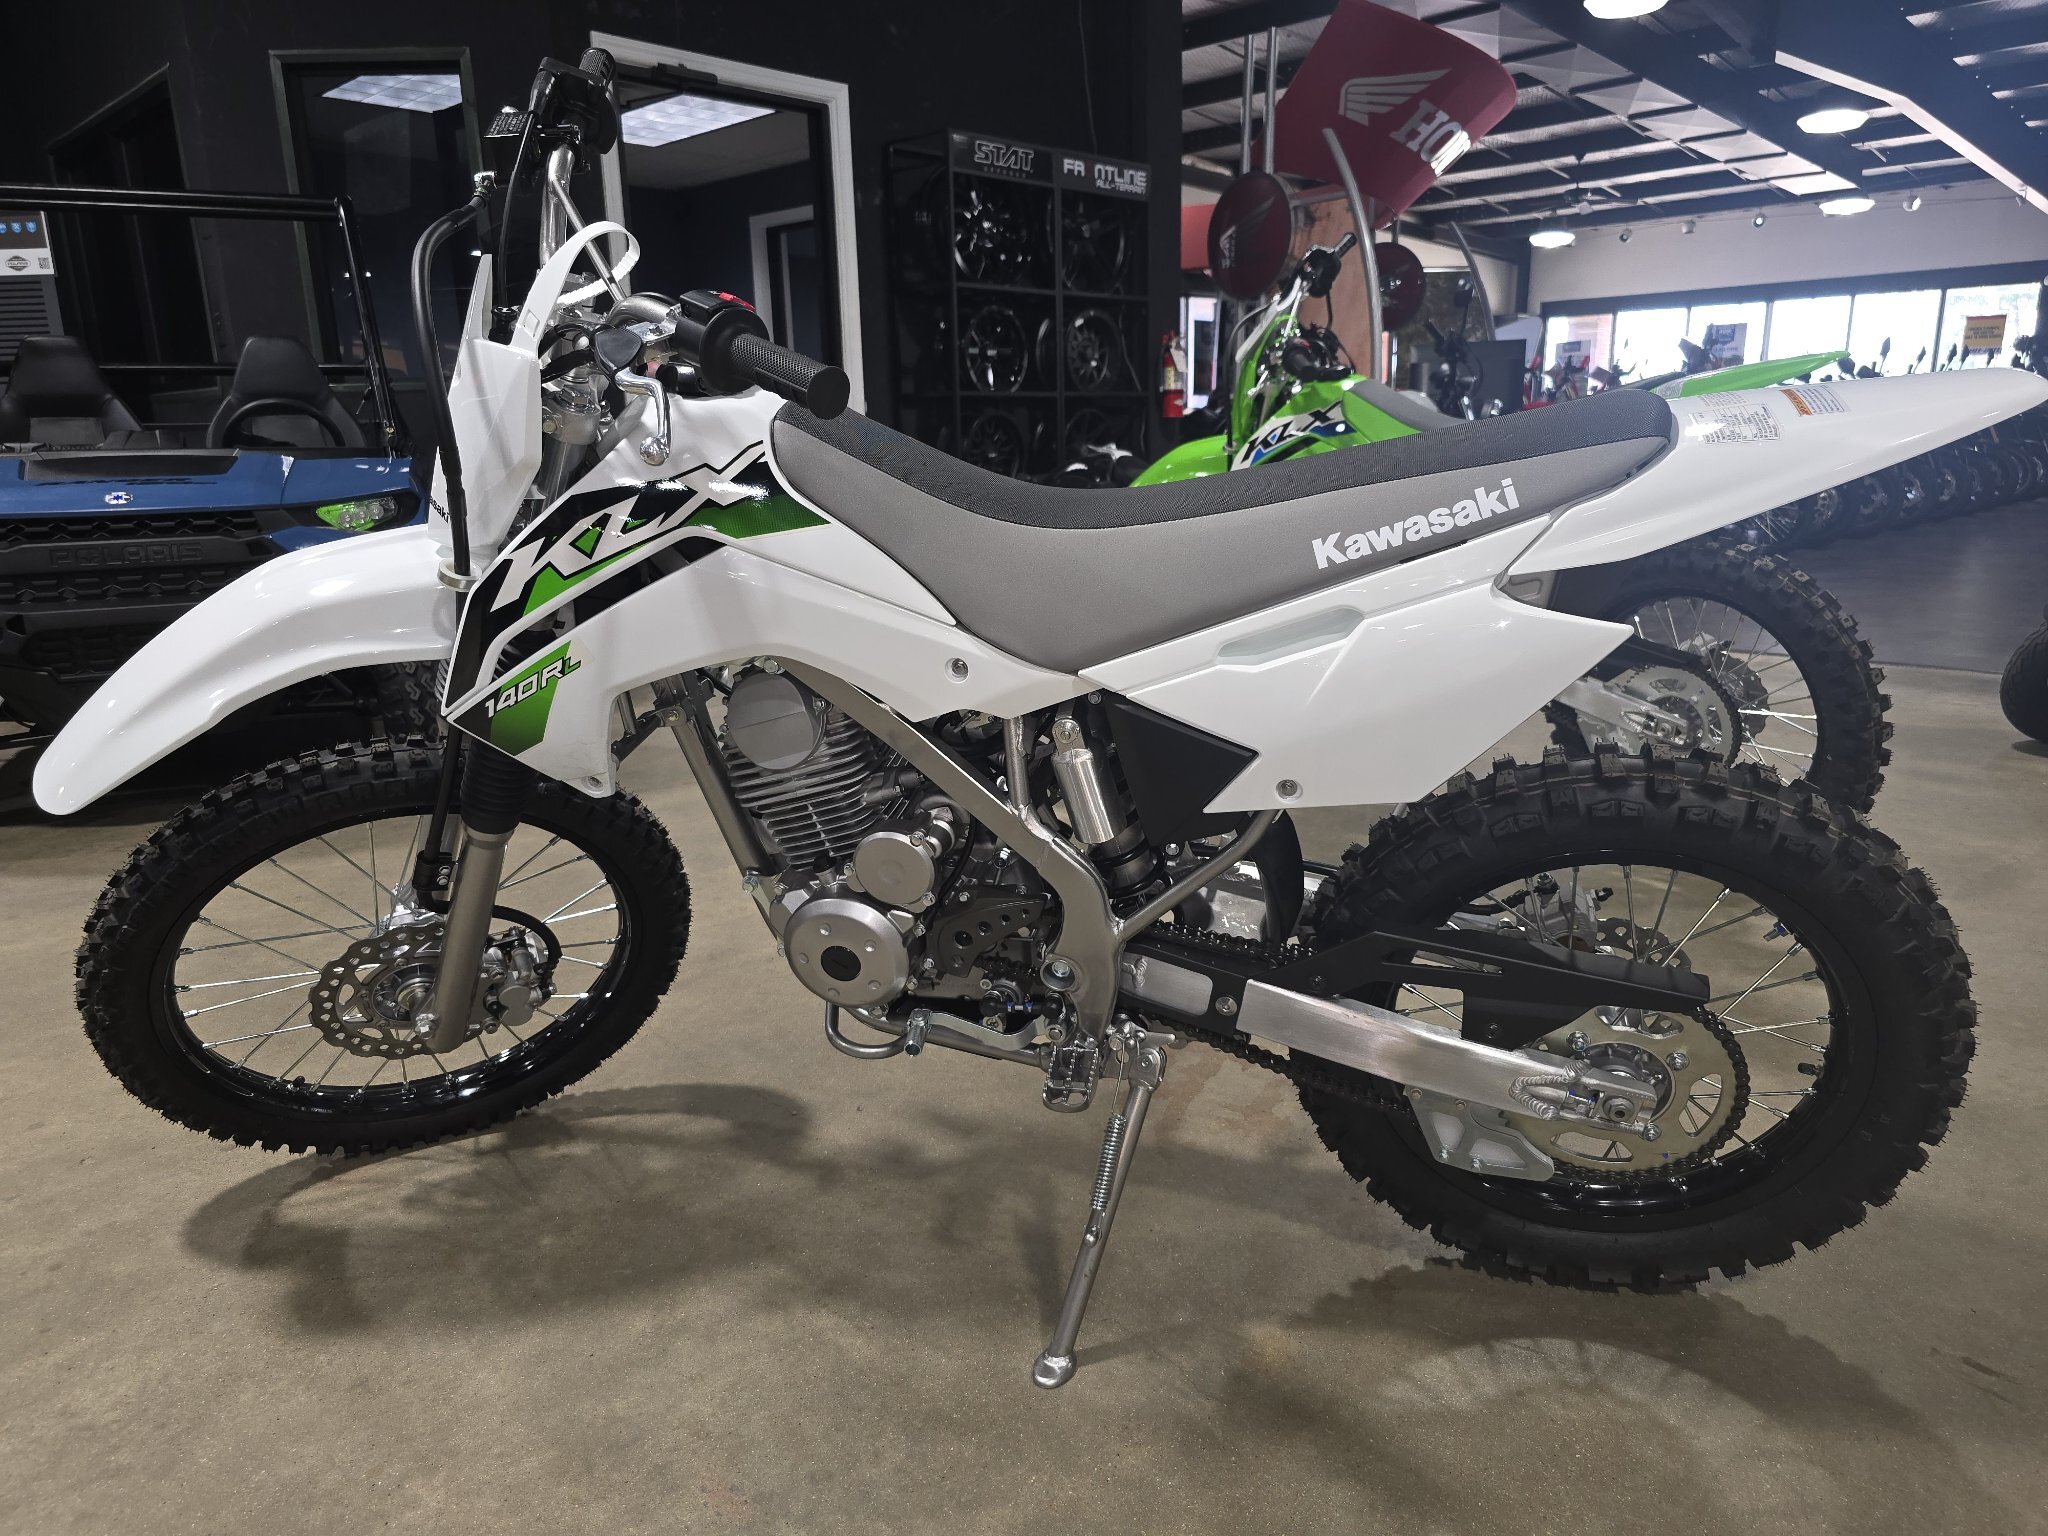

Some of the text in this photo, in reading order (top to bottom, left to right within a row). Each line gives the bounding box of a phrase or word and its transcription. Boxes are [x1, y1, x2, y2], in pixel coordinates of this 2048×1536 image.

[974, 140, 1034, 172] STAT
[1063, 158, 1147, 187] FRNTLINE
[1241, 400, 1342, 464] KLX
[489, 439, 764, 613] KLX
[1311, 477, 1520, 570] Kawasaki
[50, 541, 205, 569] POLARIS
[484, 656, 581, 718] 140RL
